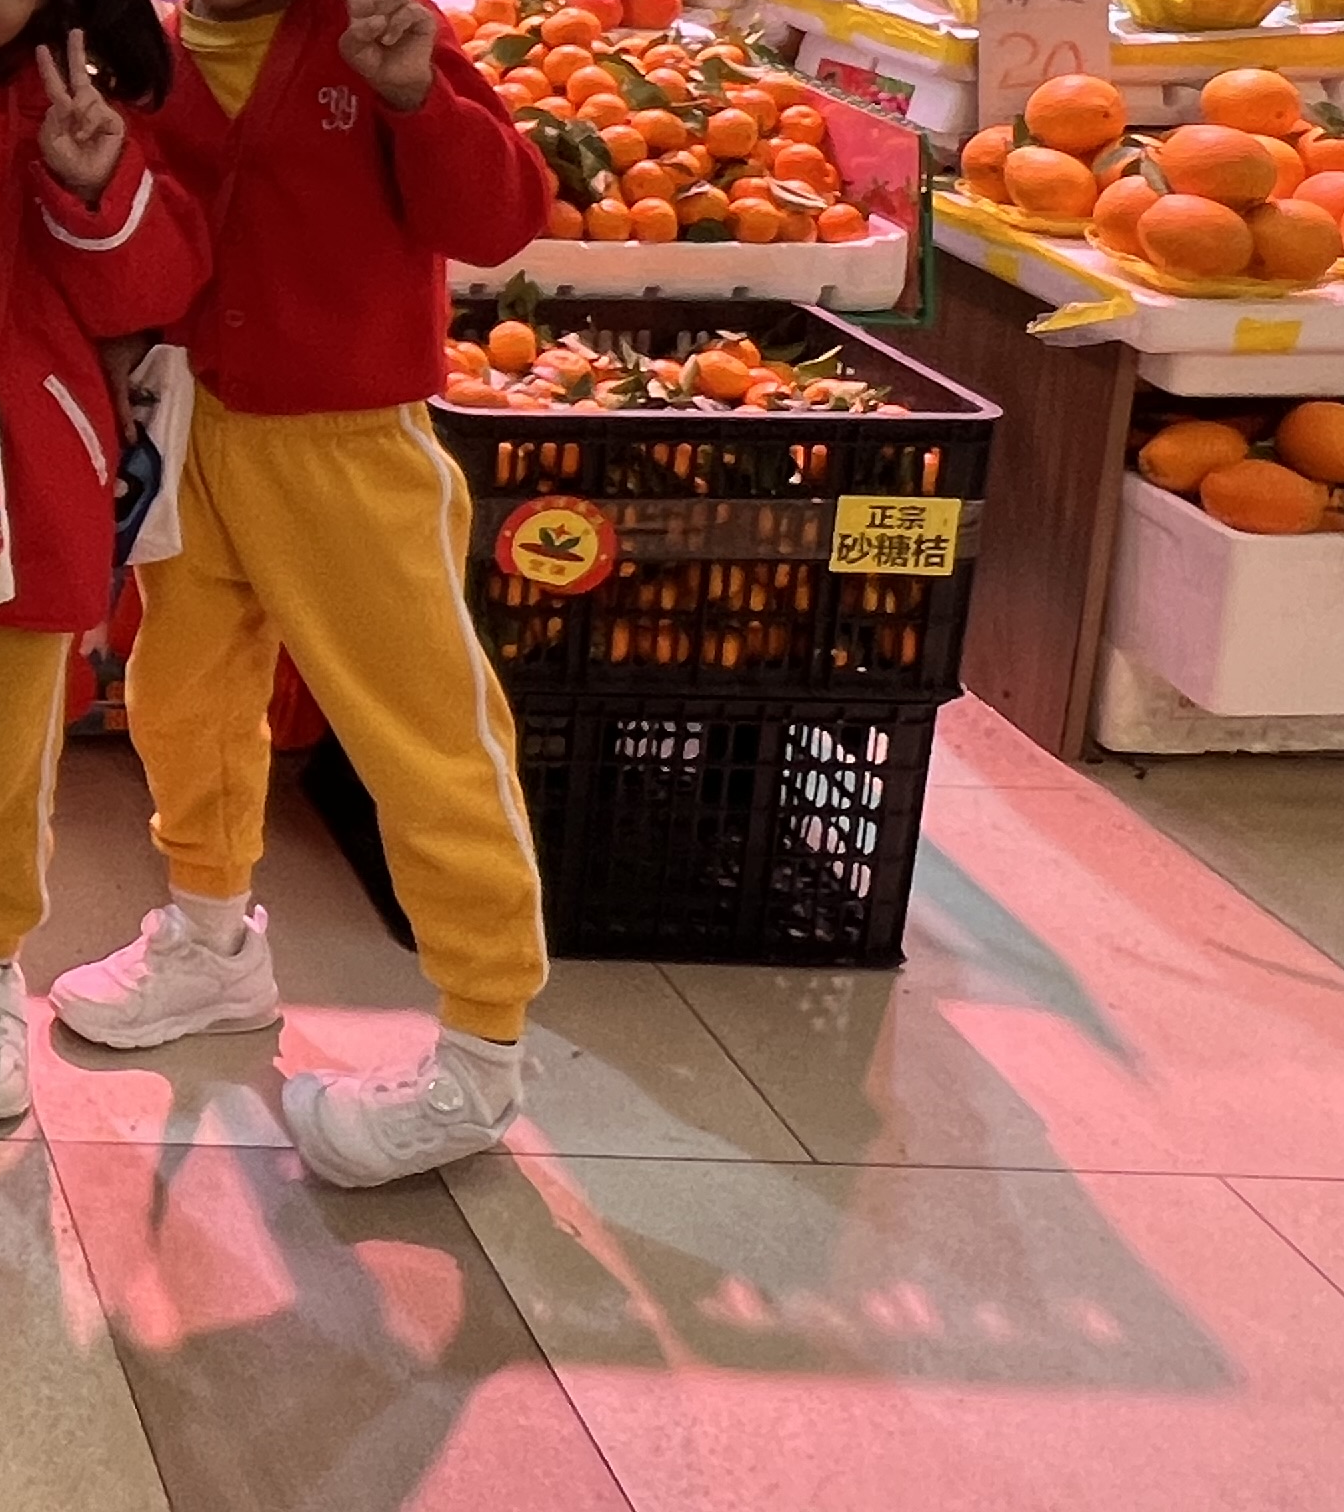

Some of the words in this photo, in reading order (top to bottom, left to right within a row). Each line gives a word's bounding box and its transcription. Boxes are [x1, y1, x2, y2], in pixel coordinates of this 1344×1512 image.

[995, 31, 1086, 89] 20
[866, 504, 928, 530] 正宗
[836, 531, 951, 569] 砂糖桔
